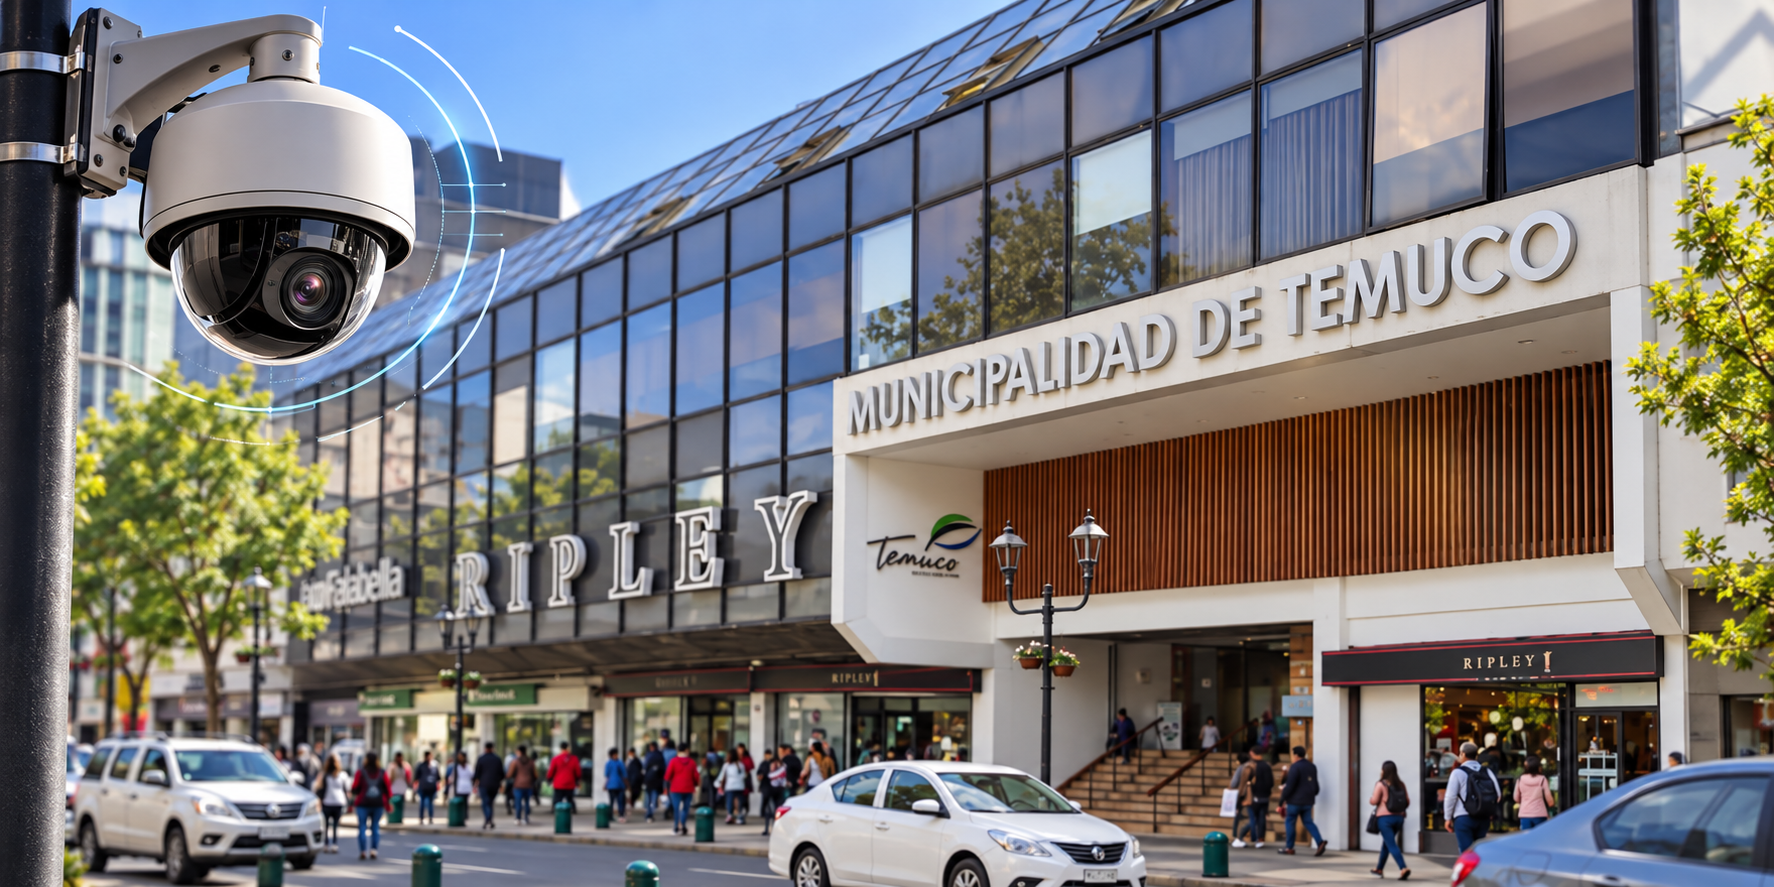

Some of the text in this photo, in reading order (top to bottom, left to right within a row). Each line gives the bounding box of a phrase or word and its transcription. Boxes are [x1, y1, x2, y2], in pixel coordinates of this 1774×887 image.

[847, 209, 1577, 435] MUNICIPALIDAD DE TEMUCO
[454, 490, 818, 618] RIPLEY
[866, 534, 960, 571] Temuco
[831, 672, 872, 684] RIPLEY
[1463, 654, 1535, 670] RIPLEY
